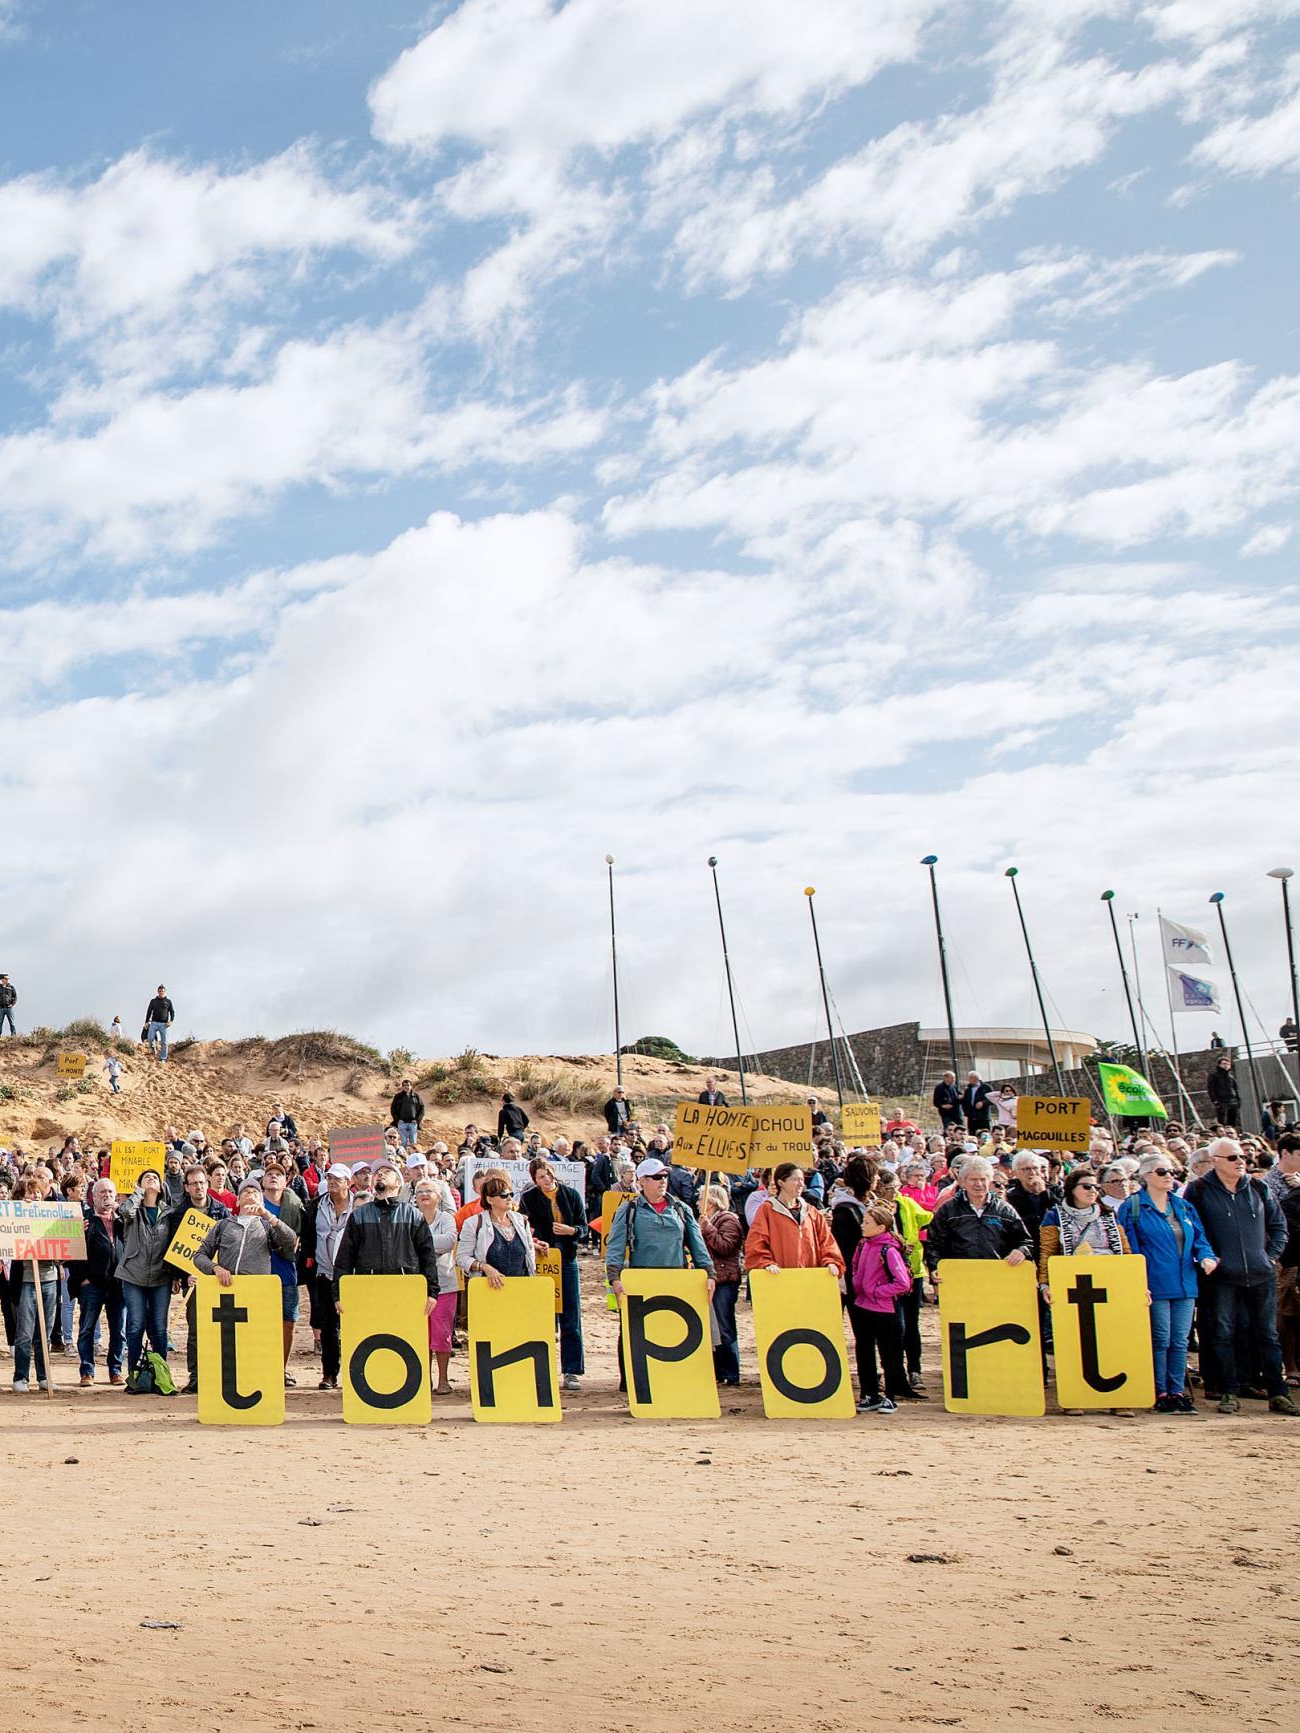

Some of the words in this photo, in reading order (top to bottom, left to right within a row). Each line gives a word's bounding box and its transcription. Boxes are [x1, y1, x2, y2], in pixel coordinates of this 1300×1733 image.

[683, 1107, 700, 1125] LA
[706, 1107, 752, 1128] HONTE
[845, 1107, 878, 1116] SAUVONS
[1035, 1101, 1081, 1115] PORT
[1017, 1130, 1086, 1142] MAGOUILLES
[765, 1142, 777, 1152] du
[782, 1142, 811, 1151] TROU
[15, 1239, 72, 1260] FAUTE
[543, 1264, 560, 1275] PAS
[1068, 1275, 1127, 1392] t
[212, 1294, 262, 1409] t
[949, 1323, 1030, 1399] r
[476, 1342, 553, 1407] n
